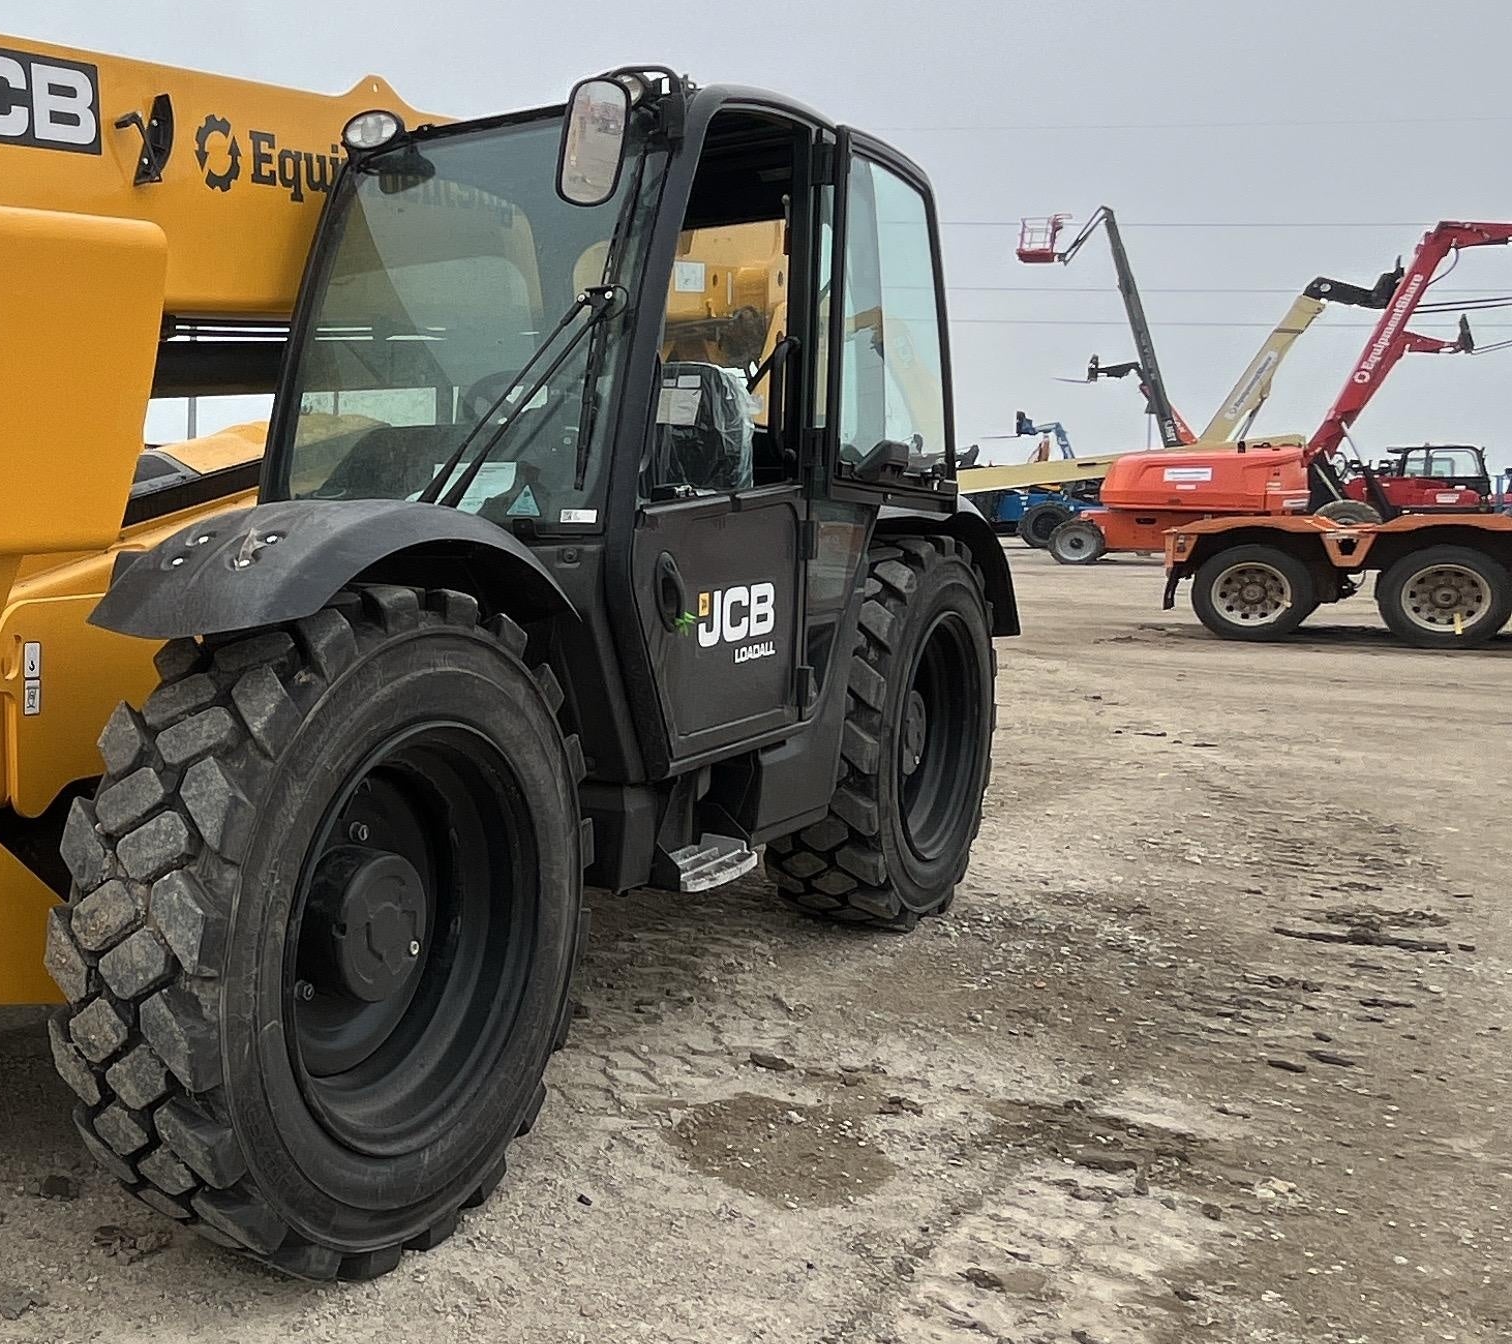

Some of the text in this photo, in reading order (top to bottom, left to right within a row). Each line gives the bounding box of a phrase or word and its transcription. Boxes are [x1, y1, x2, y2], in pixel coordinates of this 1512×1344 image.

[249, 130, 345, 203] Equi
[1360, 273, 1424, 371] EquipmentShare
[698, 582, 775, 648] JCB
[734, 641, 776, 664] LOADALL
